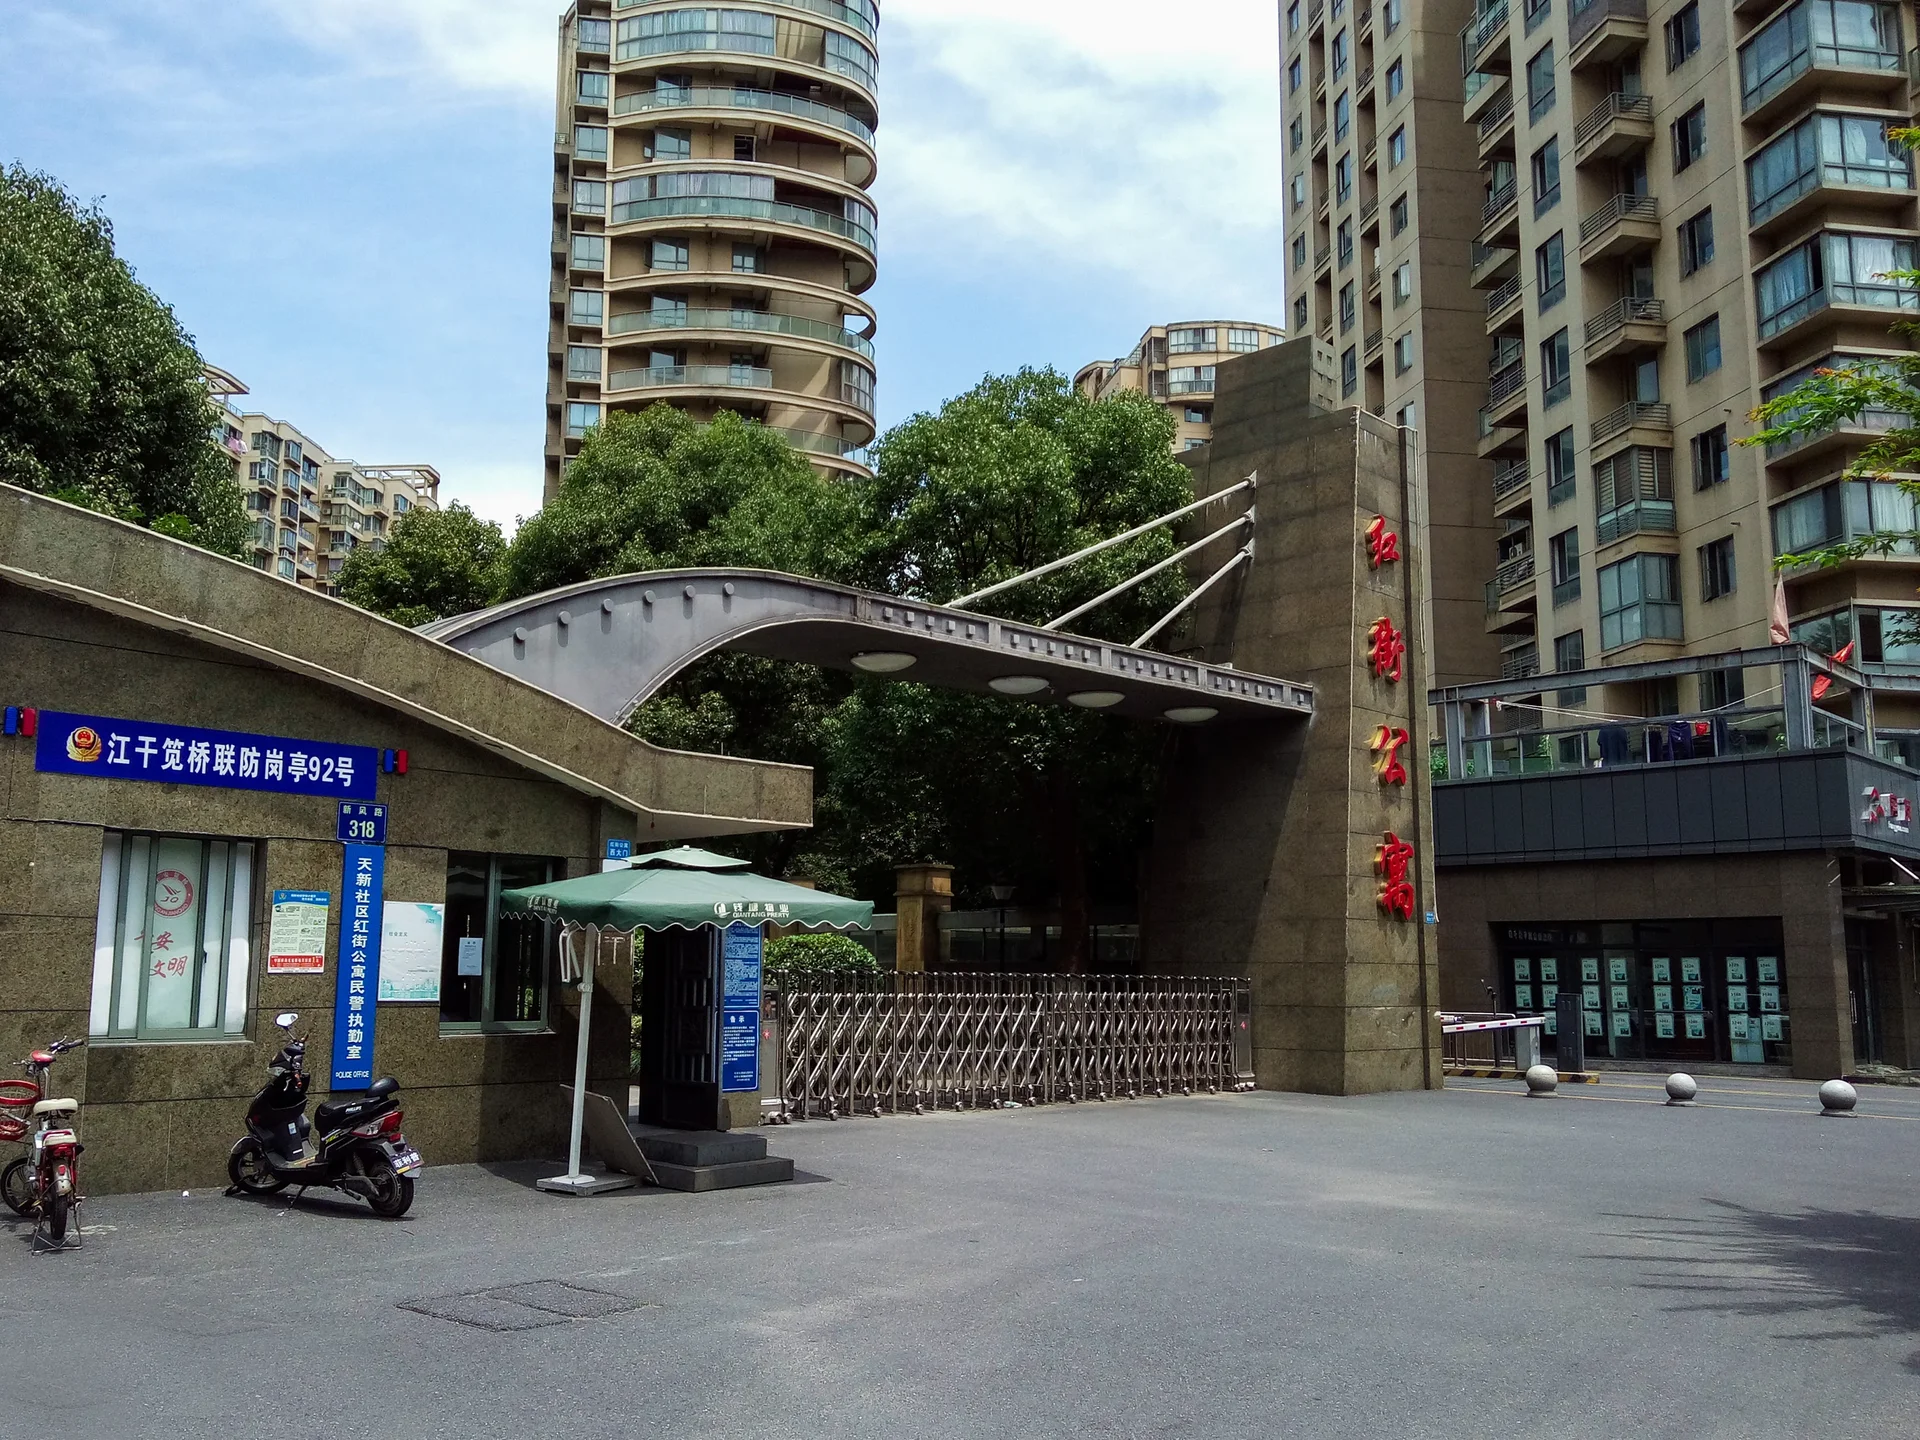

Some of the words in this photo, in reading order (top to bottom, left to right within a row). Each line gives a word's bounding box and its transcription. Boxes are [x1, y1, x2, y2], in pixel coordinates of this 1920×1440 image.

[1366, 513, 1415, 921] 红街公寓
[106, 732, 355, 787] 江干笕桥联防岗亭92号
[342, 804, 383, 817] 新风路
[348, 819, 375, 838] 318
[609, 848, 629, 857] 西大门
[149, 955, 188, 978] 文明
[346, 857, 373, 1060] 天新社区红街公寓民警执勤室
[335, 1071, 352, 1079] POLICE
[352, 1070, 370, 1078] OFFICE
